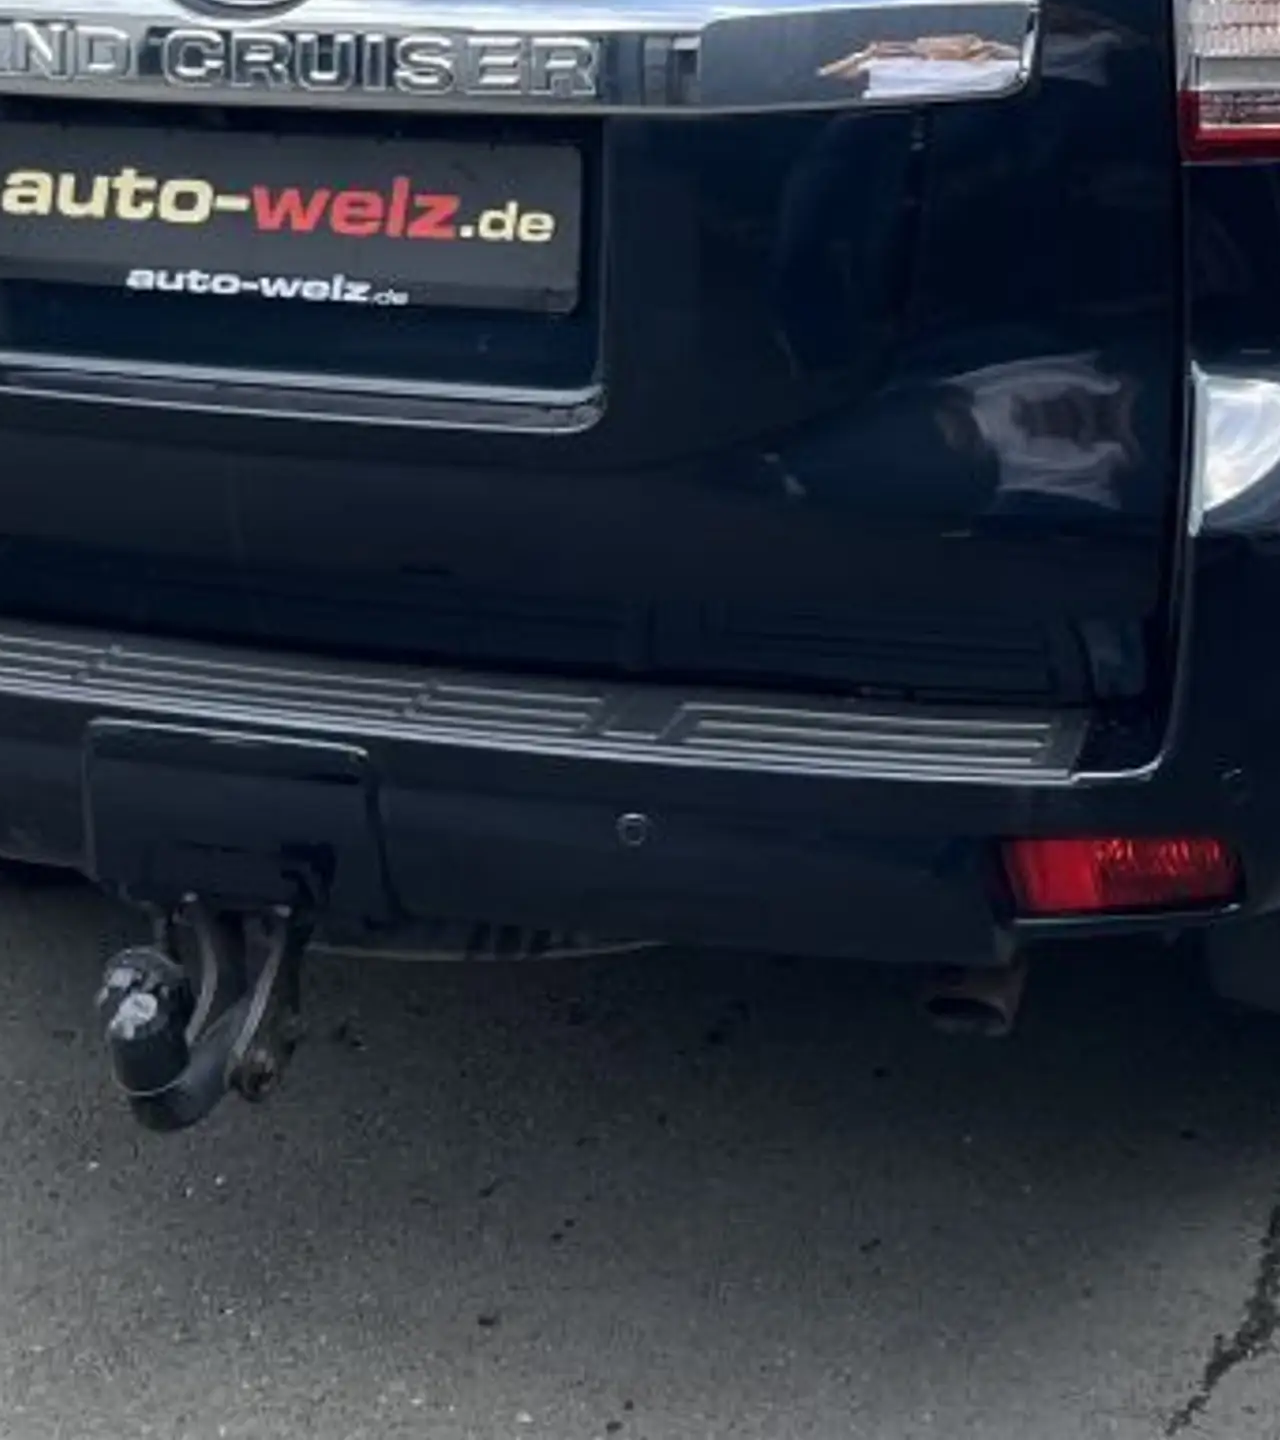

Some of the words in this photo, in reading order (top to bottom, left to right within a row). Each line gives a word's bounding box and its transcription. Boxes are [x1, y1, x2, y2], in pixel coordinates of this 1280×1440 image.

[154, 29, 601, 98] CRUISER
[0, 166, 556, 244] auto-welz.de
[126, 268, 410, 306] auto-welz.de
